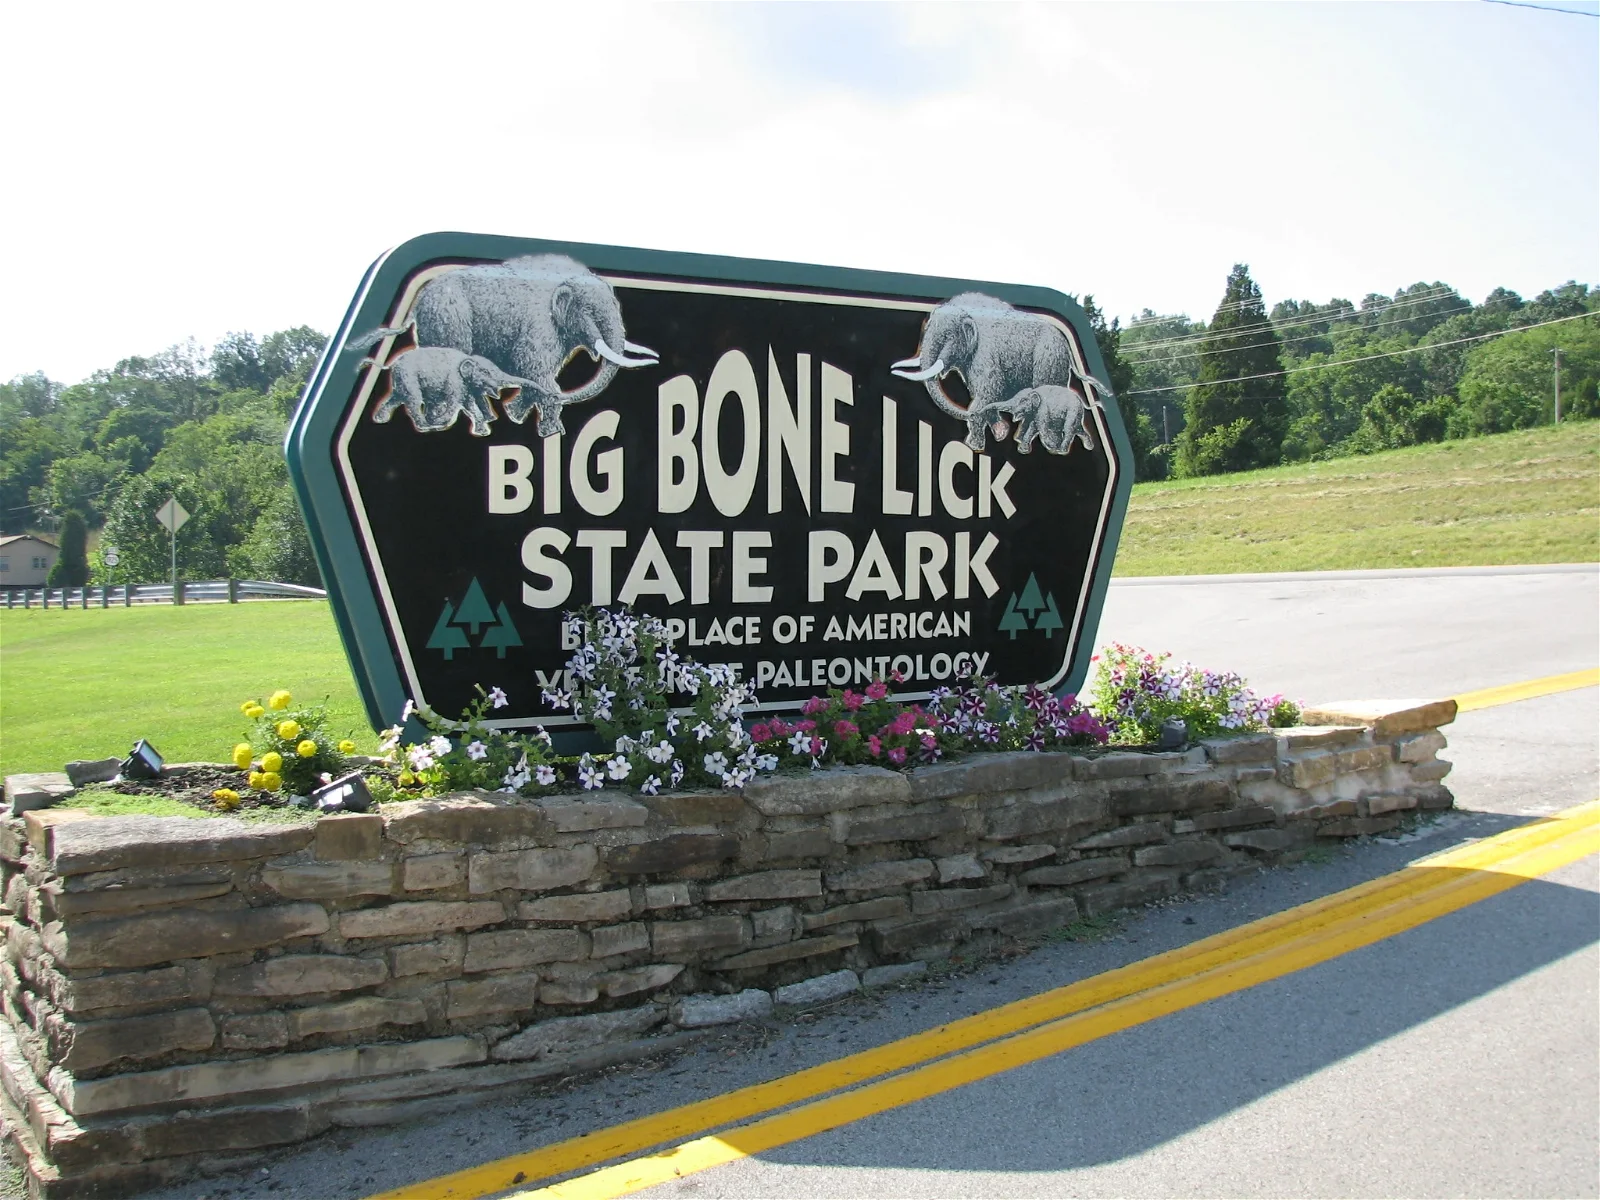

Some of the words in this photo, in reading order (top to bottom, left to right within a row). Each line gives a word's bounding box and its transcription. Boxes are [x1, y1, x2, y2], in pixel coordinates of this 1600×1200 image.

[489, 410, 624, 517] BIG
[658, 343, 855, 518] BONE
[883, 395, 1017, 519] LICK
[521, 527, 774, 609] STATE
[808, 529, 1000, 602] PARK
[772, 614, 815, 644] OF
[823, 611, 971, 642] AMERICAN
[757, 651, 990, 689] PALEONTOLOGY
